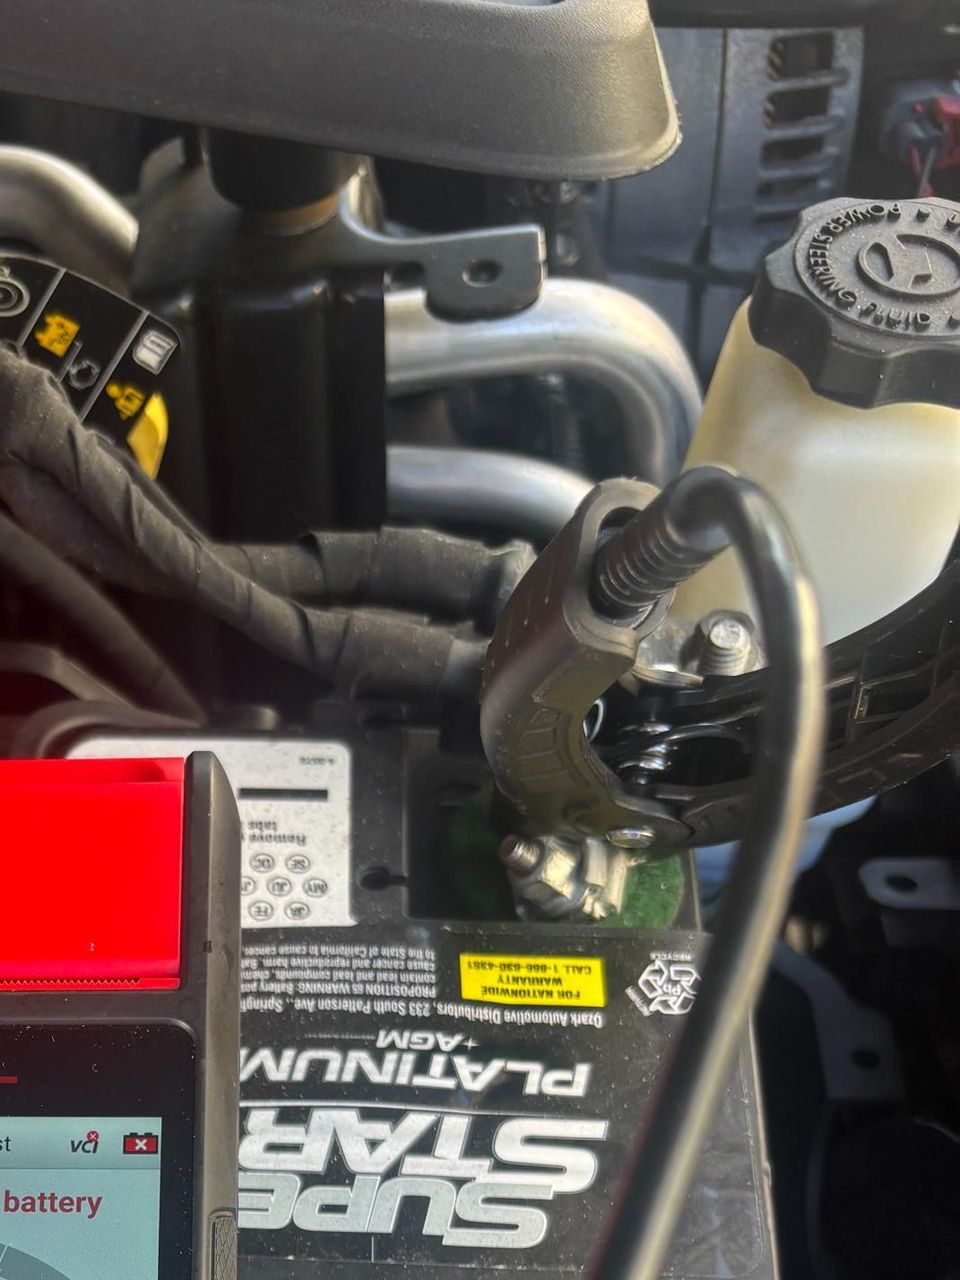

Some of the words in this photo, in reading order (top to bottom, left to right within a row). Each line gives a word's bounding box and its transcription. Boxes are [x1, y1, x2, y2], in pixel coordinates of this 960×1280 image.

[827, 203, 901, 232] POWER
[809, 233, 857, 302] STEERING
[248, 821, 277, 832] tabs
[249, 834, 306, 847] Remove
[278, 943, 308, 955] cause
[308, 944, 319, 957] to
[320, 944, 368, 959] California
[368, 945, 380, 959] of
[380, 945, 407, 960] State
[408, 947, 424, 960] the
[424, 947, 435, 961] to
[290, 955, 351, 969] reproductive
[351, 958, 371, 970] and
[372, 958, 405, 970] cancer
[407, 959, 436, 972] cause
[332, 969, 354, 982] lead
[355, 970, 375, 983] and
[564, 964, 592, 975] CALL
[376, 970, 398, 984] lead
[400, 971, 436, 984] contain
[496, 974, 563, 987] WARRANTY
[259, 980, 294, 995] Battery
[365, 983, 437, 999] PROPOSITION
[480, 986, 554, 999] NATIONWIDE
[557, 989, 580, 1000] FOR
[662, 982, 682, 996] Pb
[317, 997, 372, 1015] Patterson
[373, 999, 407, 1017] South
[409, 1000, 432, 1017] 233
[432, 1001, 501, 1024] Distributors,
[503, 1010, 568, 1027] Automotive
[569, 1012, 603, 1029] Ozark
[239, 1044, 592, 1098] PLATINUM
[3, 1190, 103, 1220] battery
